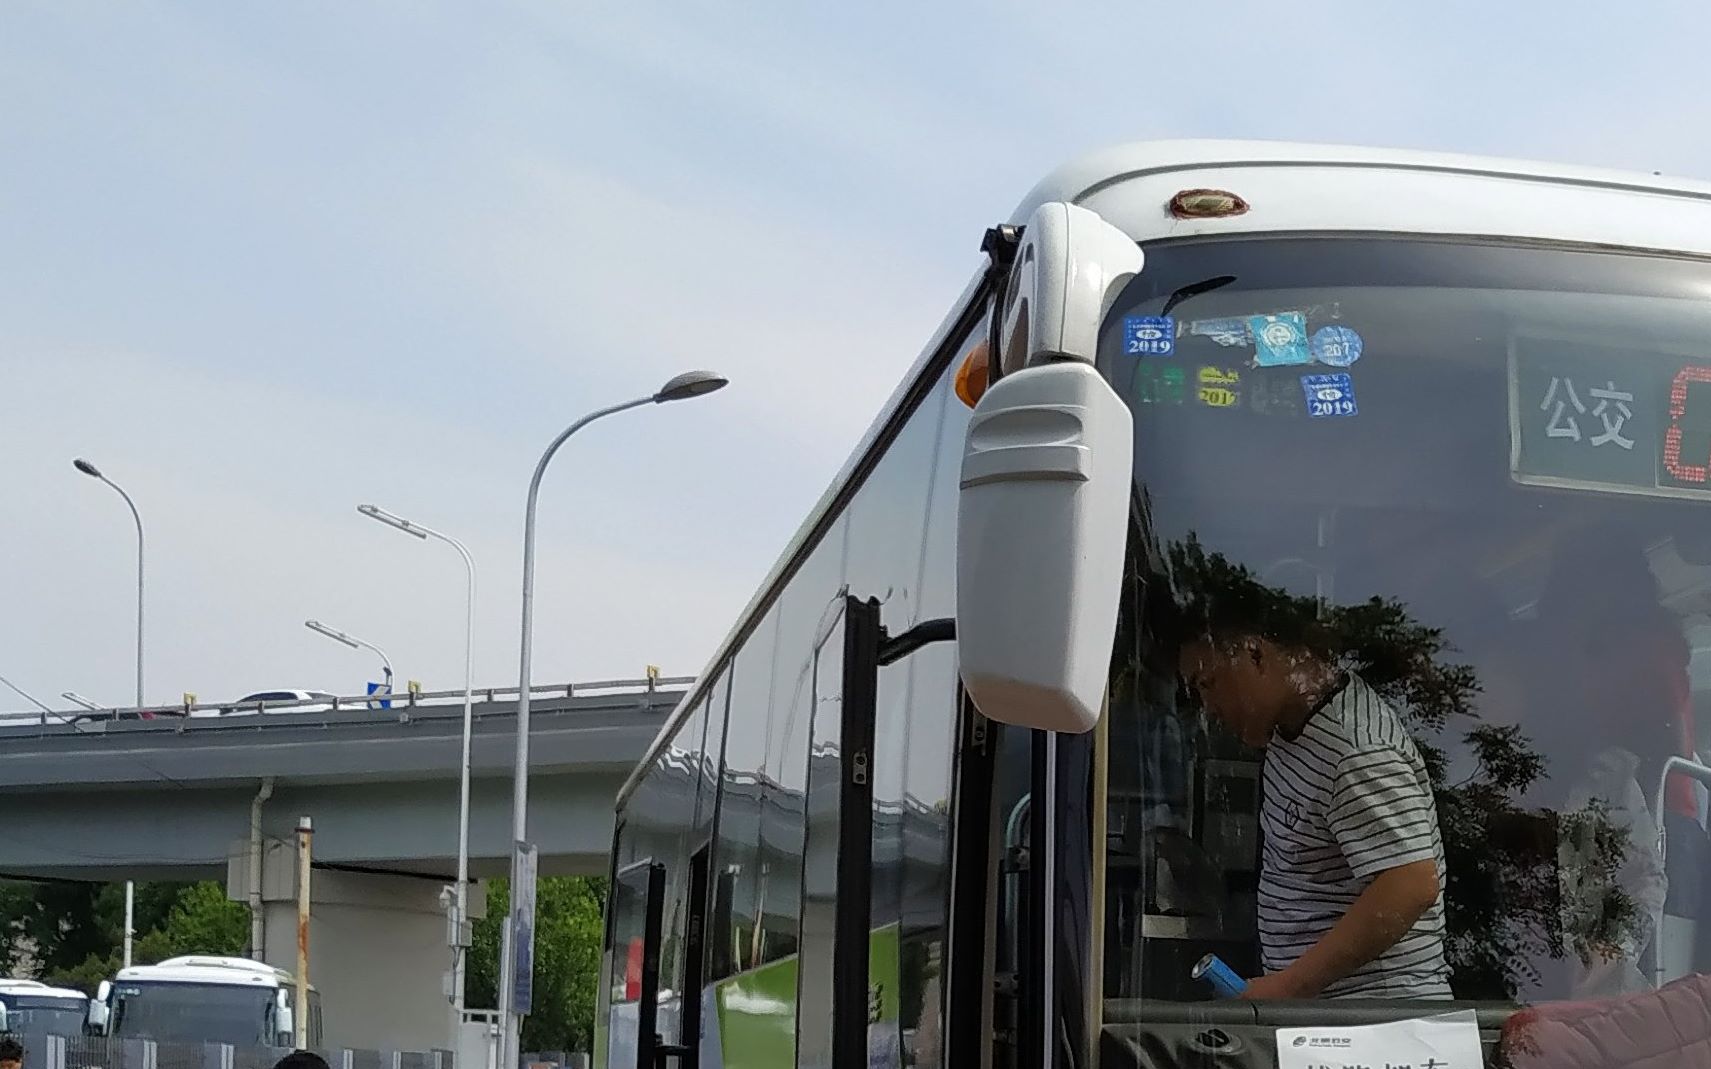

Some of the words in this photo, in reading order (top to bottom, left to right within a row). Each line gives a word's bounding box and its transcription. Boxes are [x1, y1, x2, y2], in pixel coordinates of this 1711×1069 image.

[1128, 340, 1171, 353] 2019
[1199, 389, 1234, 405] 201
[1312, 400, 1353, 416] 2019
[1540, 376, 1635, 450] 公交
